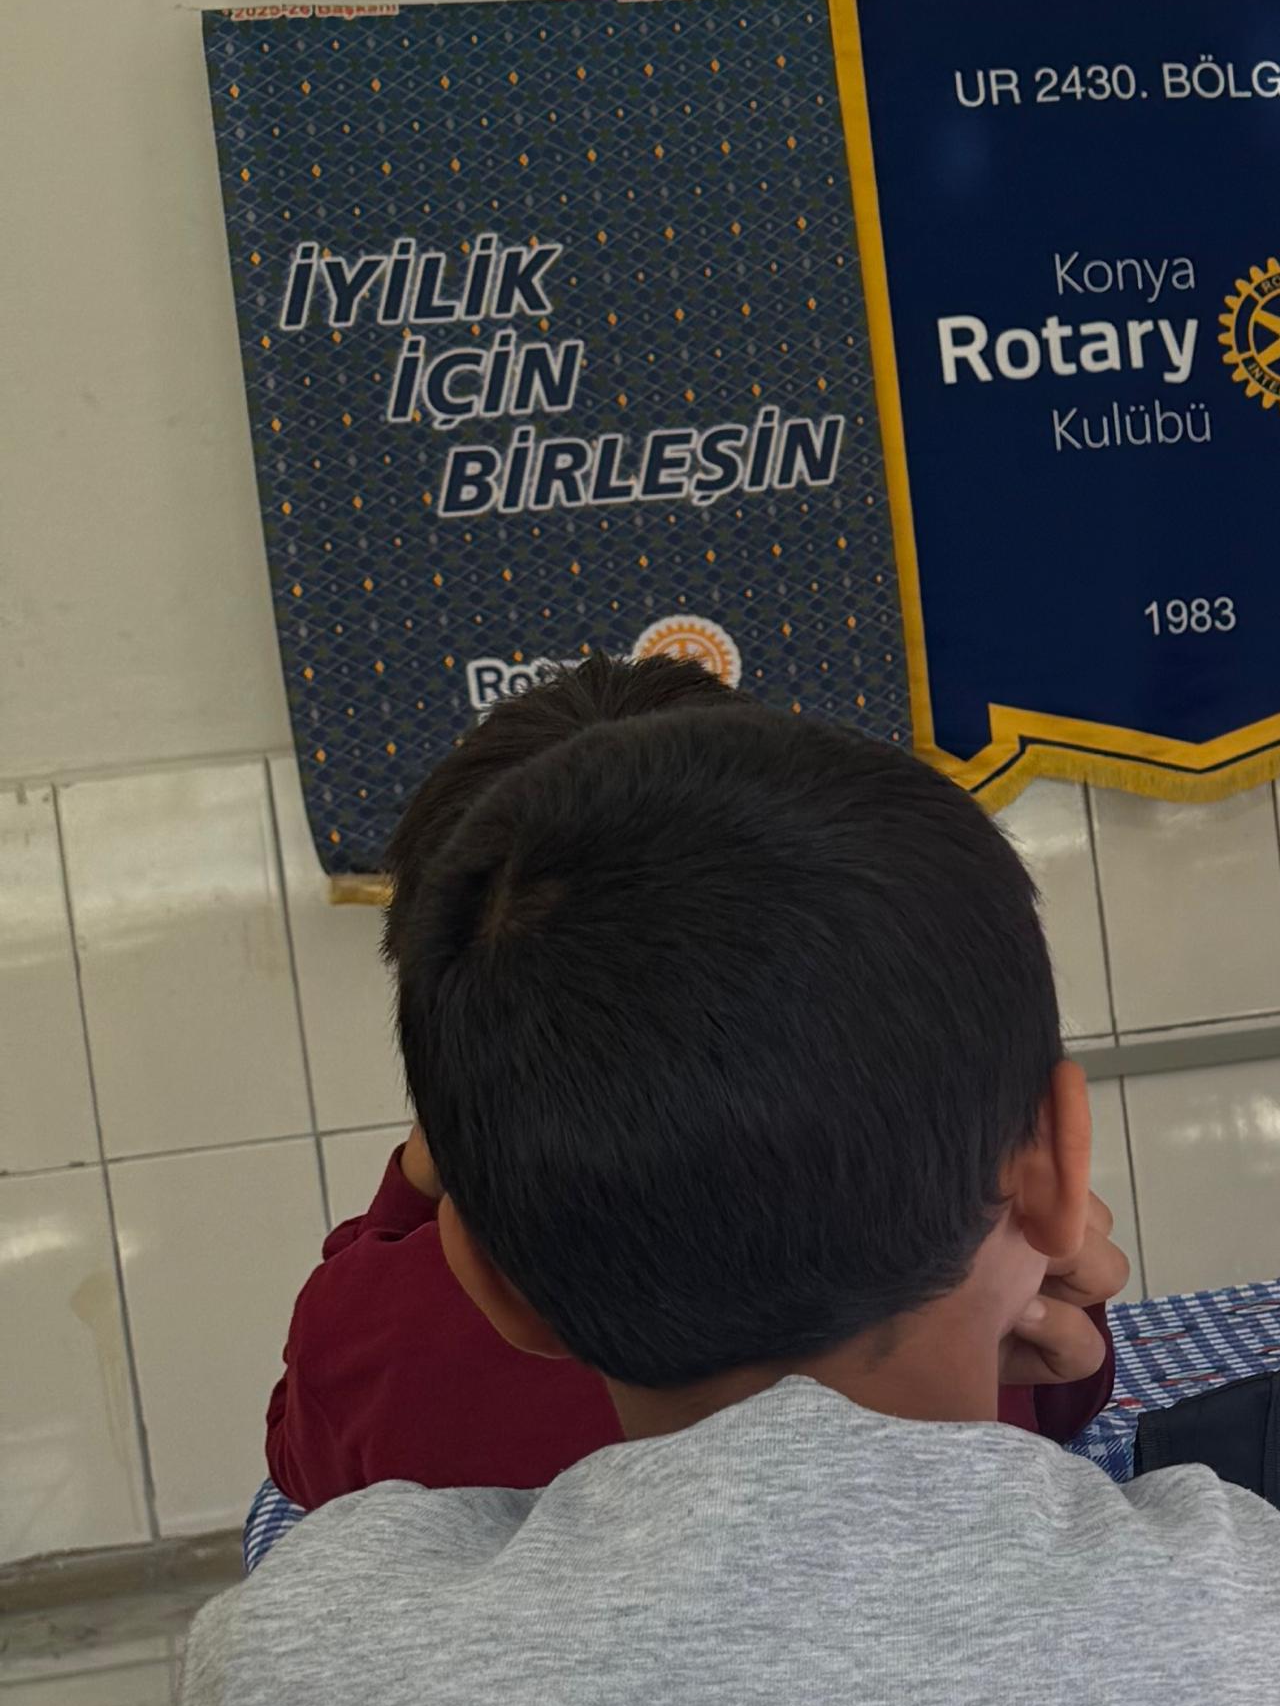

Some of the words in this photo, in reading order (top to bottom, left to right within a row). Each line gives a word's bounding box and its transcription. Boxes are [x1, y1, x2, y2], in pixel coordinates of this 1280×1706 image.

[954, 69, 1021, 108] UR
[1034, 65, 1149, 103] 2430.
[281, 233, 563, 330] İYİLİK
[1054, 250, 1196, 303] Konya
[936, 314, 1199, 384] Rotary
[387, 331, 585, 430] İÇİN
[1051, 399, 1212, 452] Kulübü
[437, 405, 847, 518] BİRLEŞİN
[1144, 597, 1238, 635] 1983
